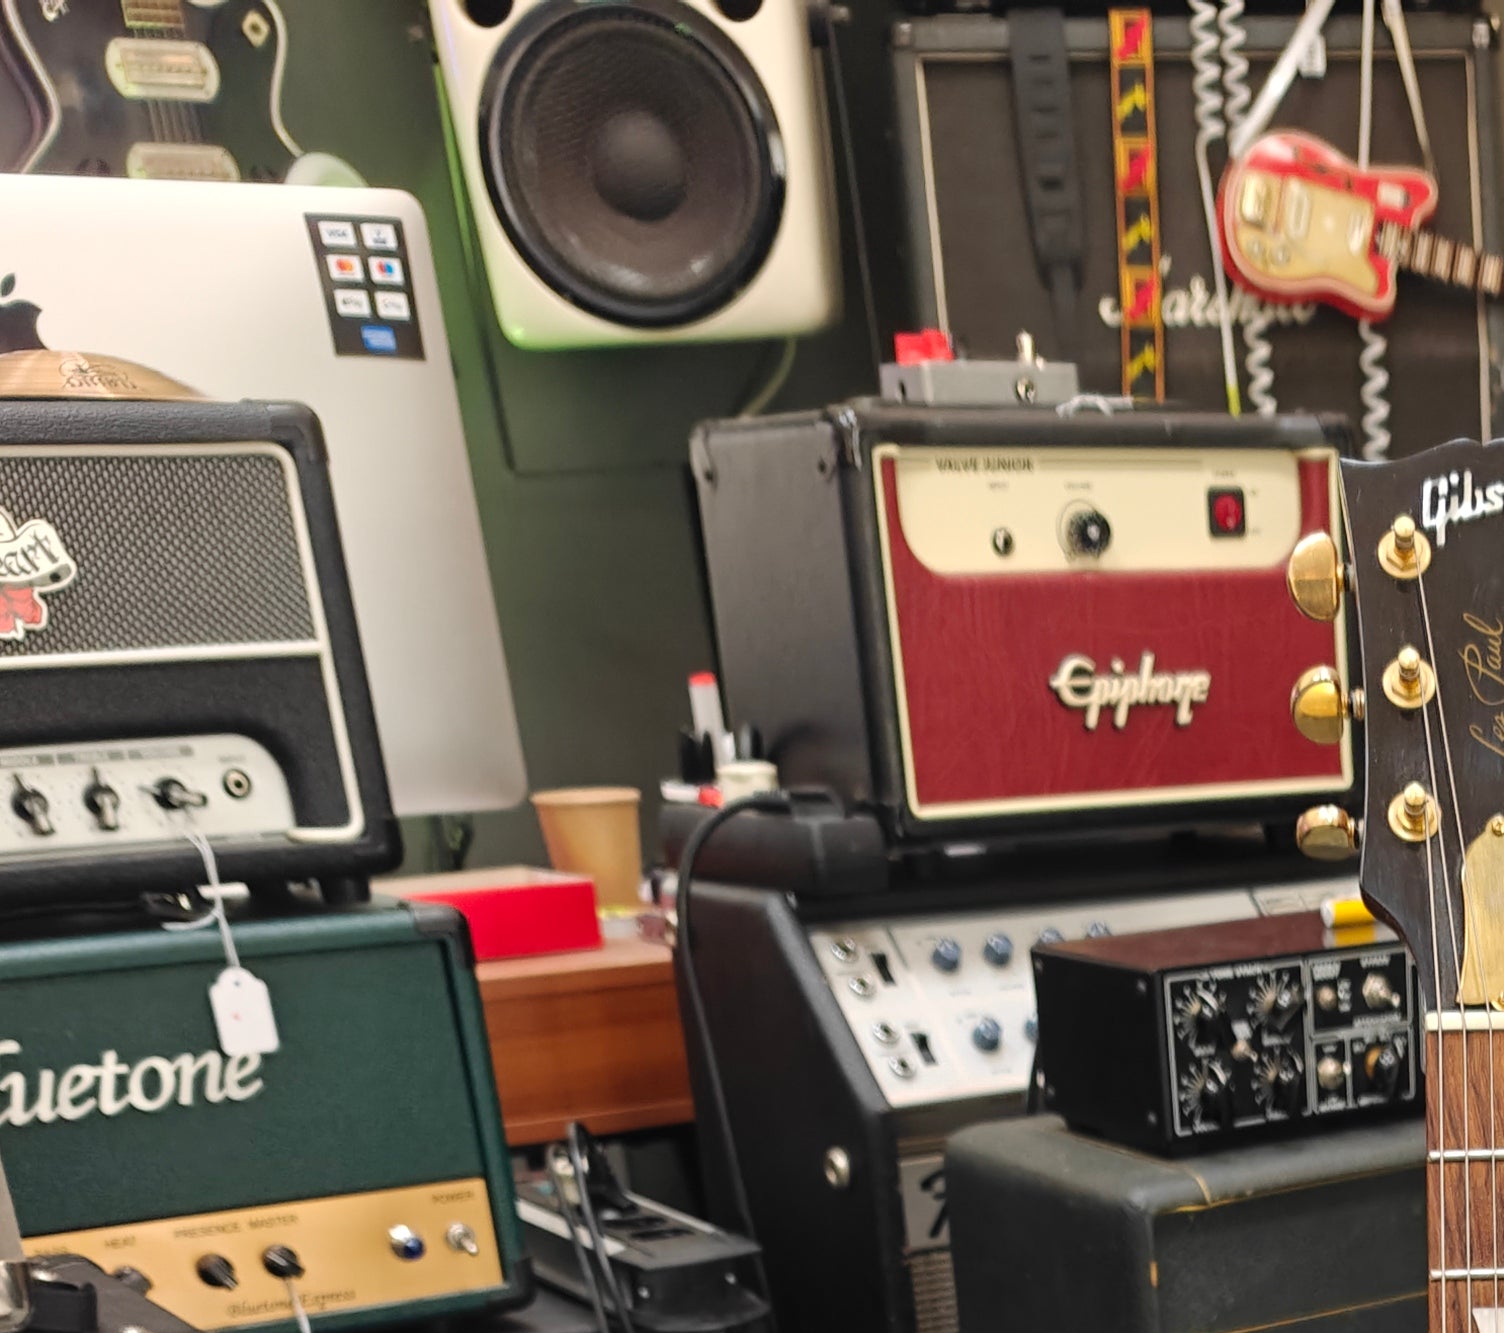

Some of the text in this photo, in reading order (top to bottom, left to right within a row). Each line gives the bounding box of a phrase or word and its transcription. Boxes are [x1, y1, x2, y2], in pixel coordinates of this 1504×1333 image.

[936, 456, 1036, 474] VALVE JUNIOR
[1049, 648, 1212, 730] Epiphone
[0, 1039, 264, 1127] uetone
[174, 1222, 241, 1240] PRESENCE
[248, 1214, 299, 1232] MASTER
